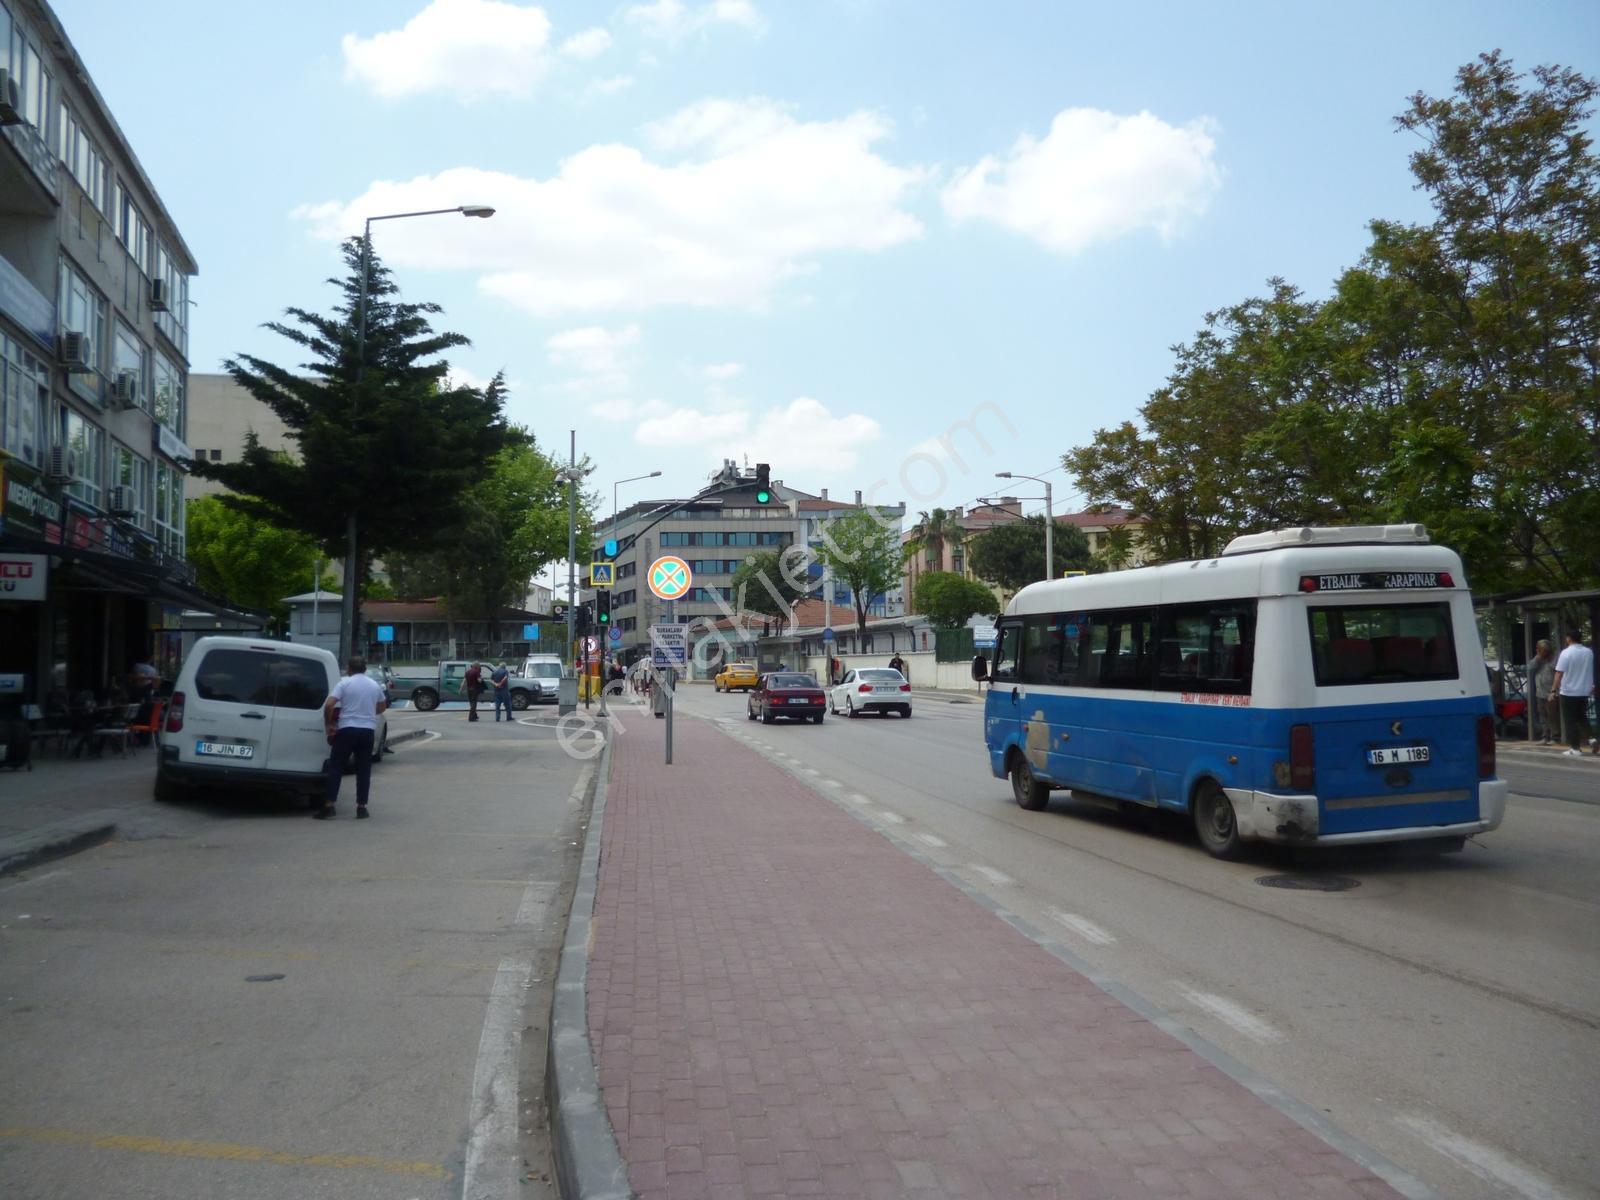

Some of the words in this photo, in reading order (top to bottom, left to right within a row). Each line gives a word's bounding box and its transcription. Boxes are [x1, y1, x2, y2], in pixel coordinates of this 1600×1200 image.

[1384, 573, 1438, 588] KARAPINAR
[203, 743, 213, 753] 16
[218, 745, 235, 754] JIN
[239, 746, 252, 755] 87
[1372, 750, 1385, 763] 16
[1391, 749, 1400, 762] M
[1406, 748, 1429, 761] 1189
